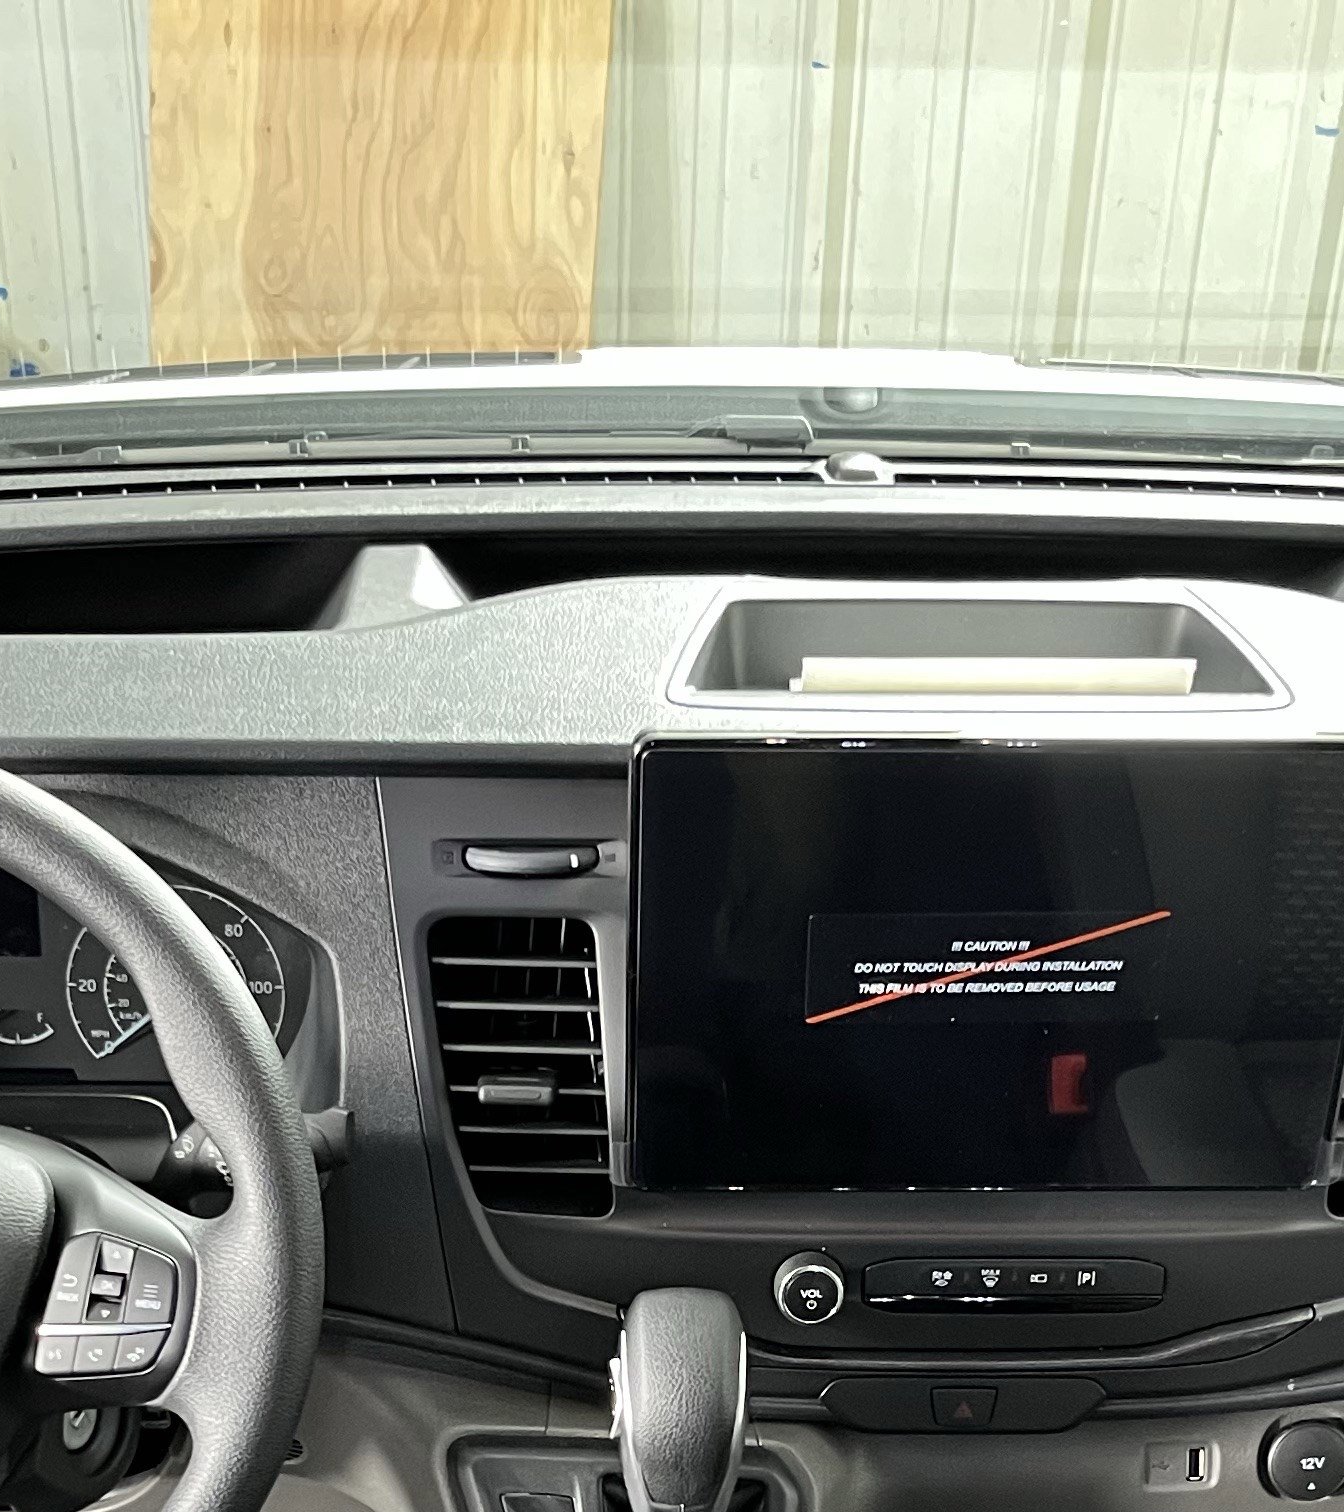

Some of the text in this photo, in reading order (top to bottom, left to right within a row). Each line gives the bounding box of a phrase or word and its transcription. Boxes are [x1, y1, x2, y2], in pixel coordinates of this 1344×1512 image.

[224, 924, 244, 938] 80
[964, 941, 1017, 952] CAUTION
[854, 961, 1124, 974] DO NOT TOUCH DISPLAY DURING INSTALLATION
[78, 979, 97, 993] 20
[249, 981, 273, 994] 100
[859, 981, 1116, 994] THIS FILM IS TO BE REMOVED BEFORE USAGE
[799, 1289, 824, 1299] VOL
[1299, 1456, 1326, 1470] 12V
